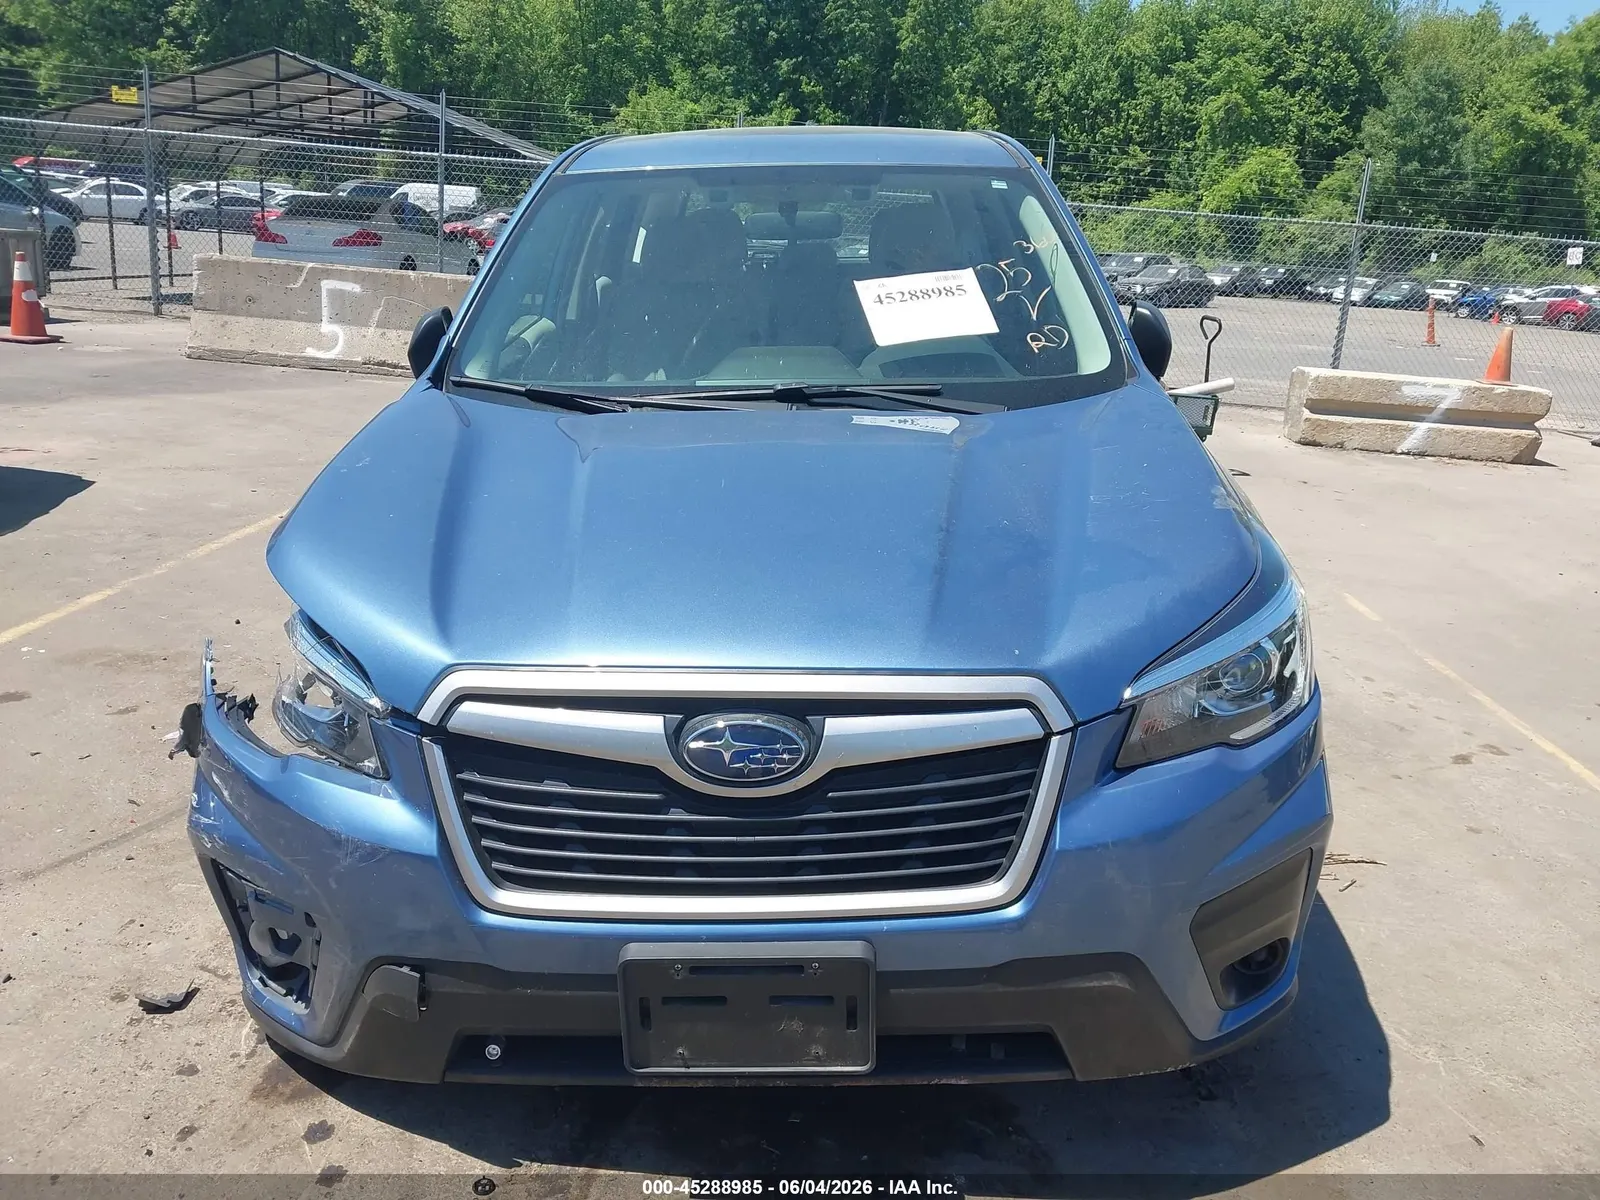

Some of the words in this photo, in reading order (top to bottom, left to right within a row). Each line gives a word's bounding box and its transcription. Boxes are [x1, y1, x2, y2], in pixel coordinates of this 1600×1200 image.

[305, 279, 362, 358] 5
[873, 284, 967, 305] 45288985
[1397, 385, 1463, 453] 7
